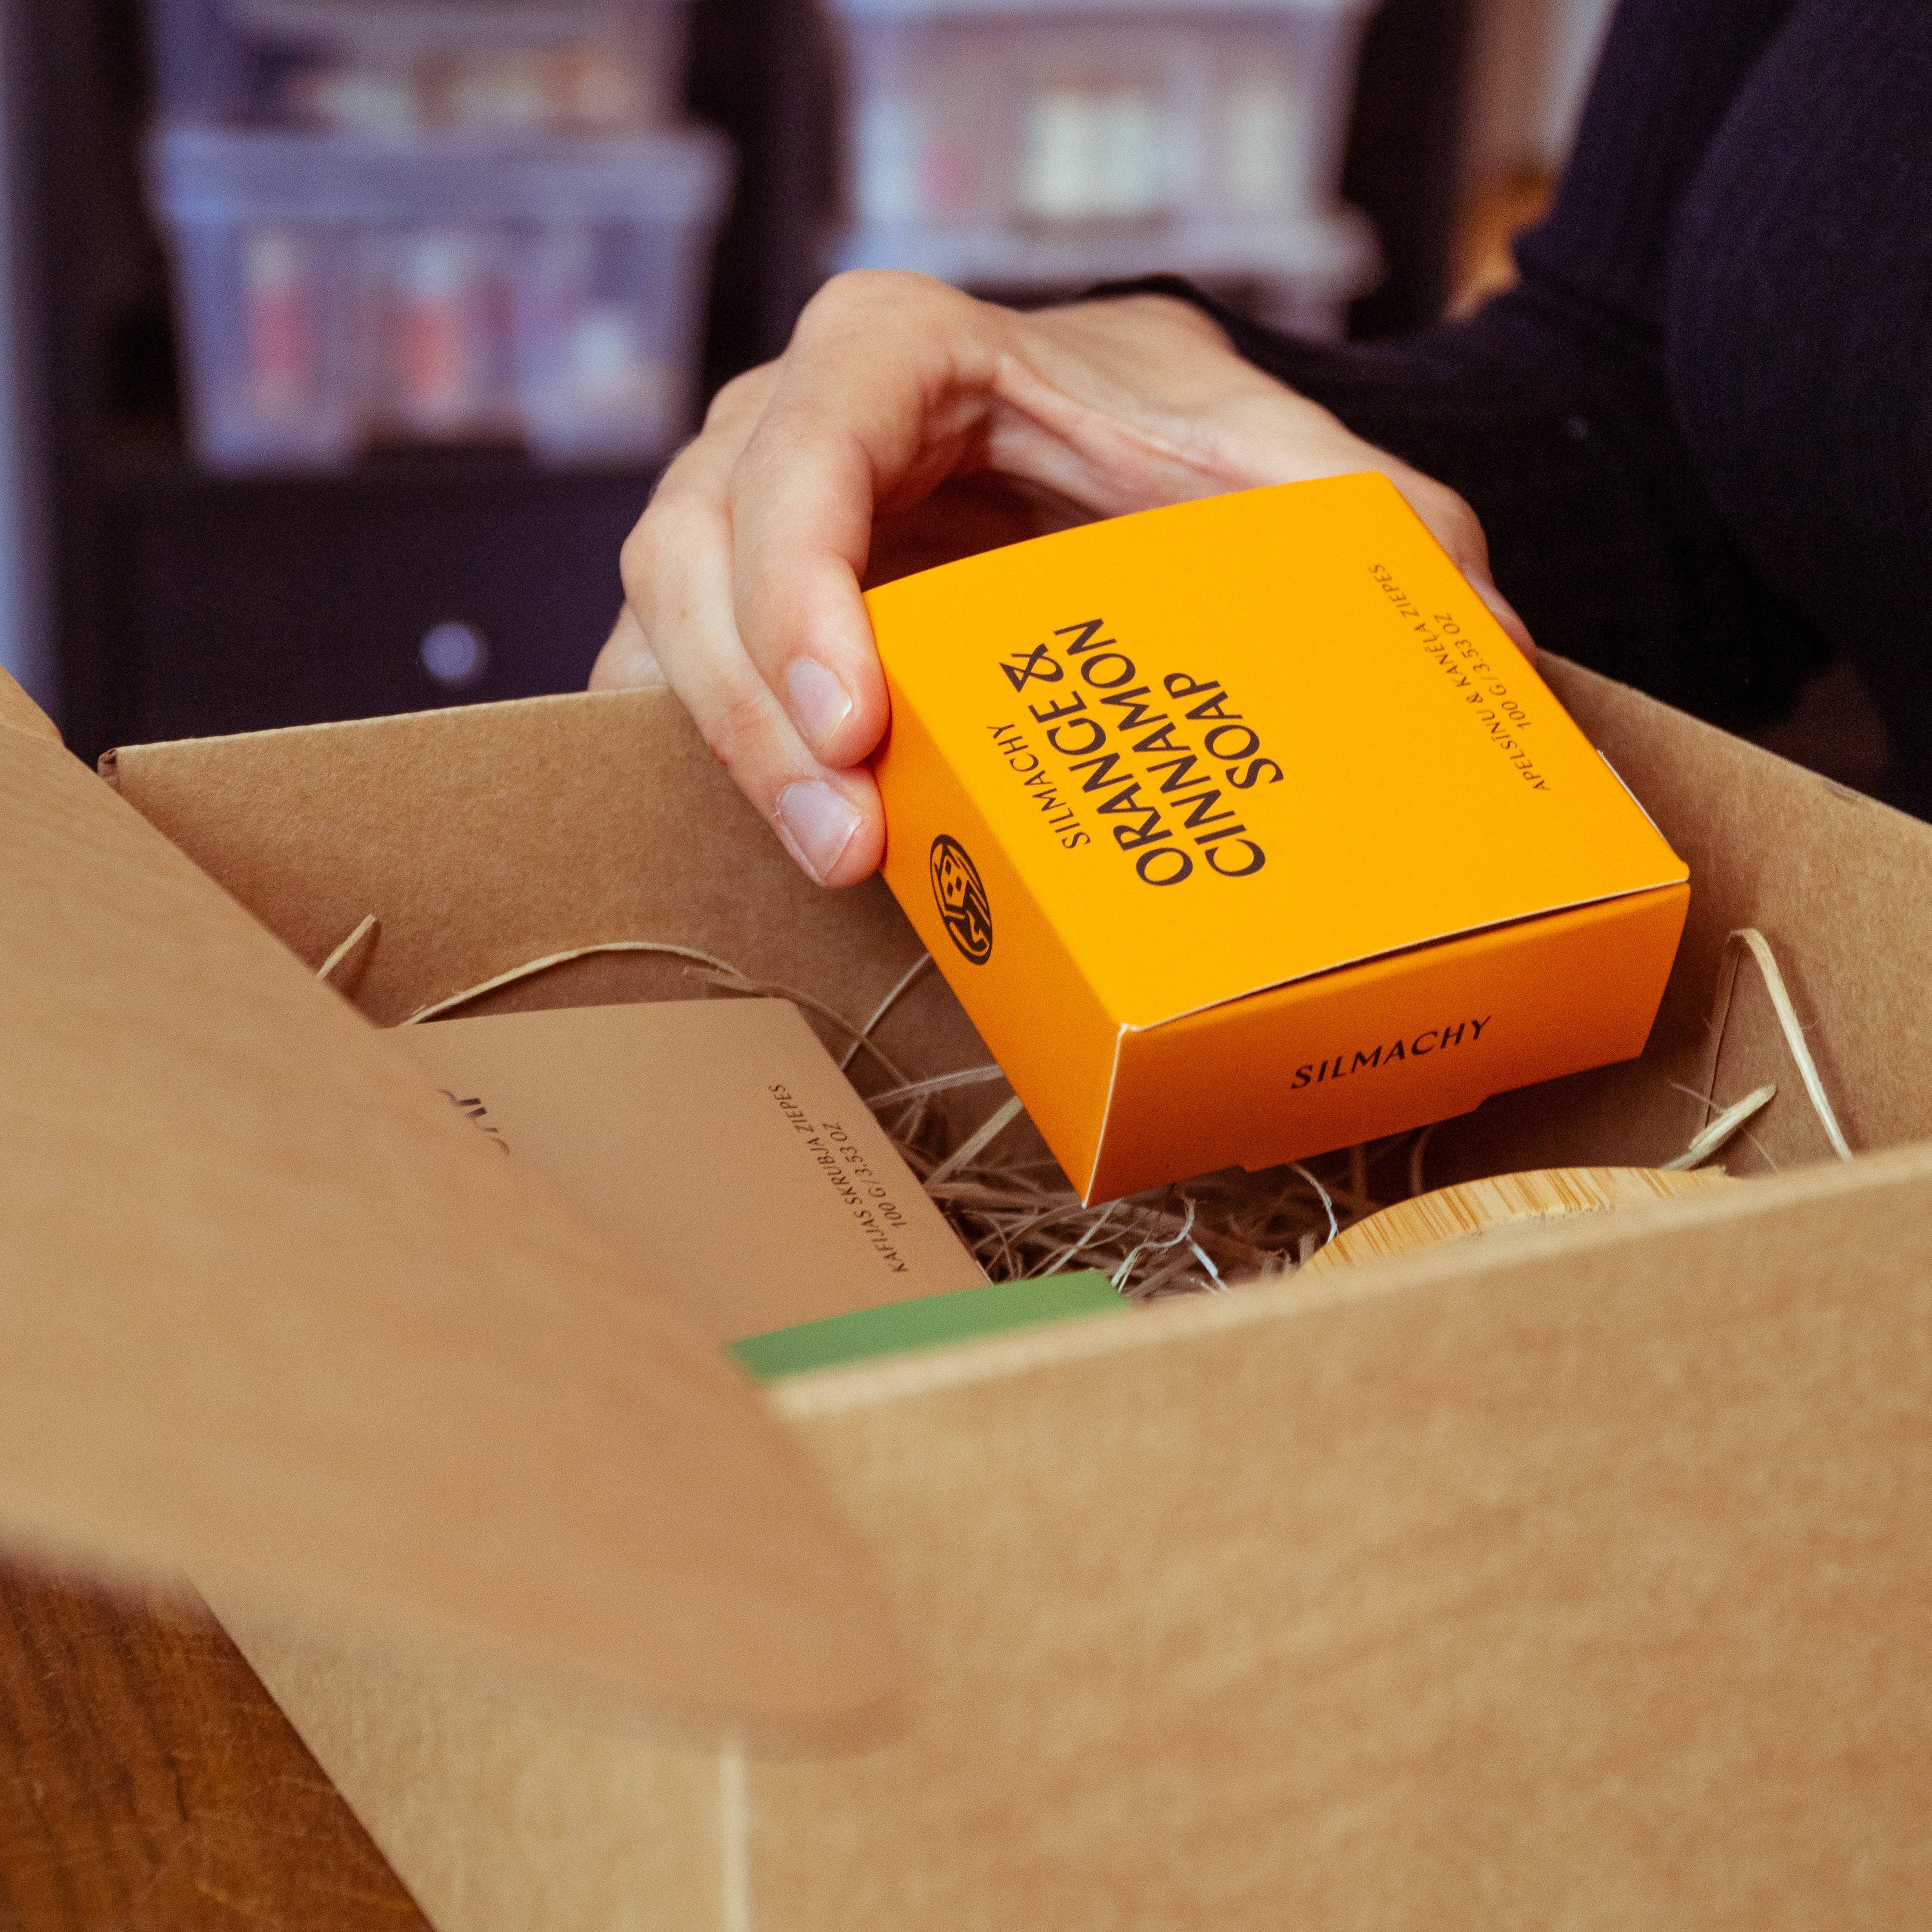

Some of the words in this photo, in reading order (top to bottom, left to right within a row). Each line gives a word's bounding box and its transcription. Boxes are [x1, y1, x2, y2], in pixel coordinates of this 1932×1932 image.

[1368, 564, 1420, 619] ZIEPES
[1433, 613, 1460, 634] OZ
[999, 643, 1064, 693] &
[1466, 692, 1484, 703] &
[1501, 700, 1531, 729] 100
[1053, 618, 1266, 877] CINNAMON
[1163, 672, 1284, 789] SOAP
[1476, 709, 1551, 791] APELSĪNU
[986, 723, 1091, 848] SILMACHY
[1027, 690, 1193, 886] ORANGE
[1291, 1015, 1492, 1089] SILMACHY
[768, 1084, 814, 1133] ZIEPES
[822, 1123, 847, 1141] OZ
[806, 1137, 863, 1205] SKRUBJA
[854, 1210, 909, 1272] KAFIJAS
[878, 1202, 907, 1228] 100
